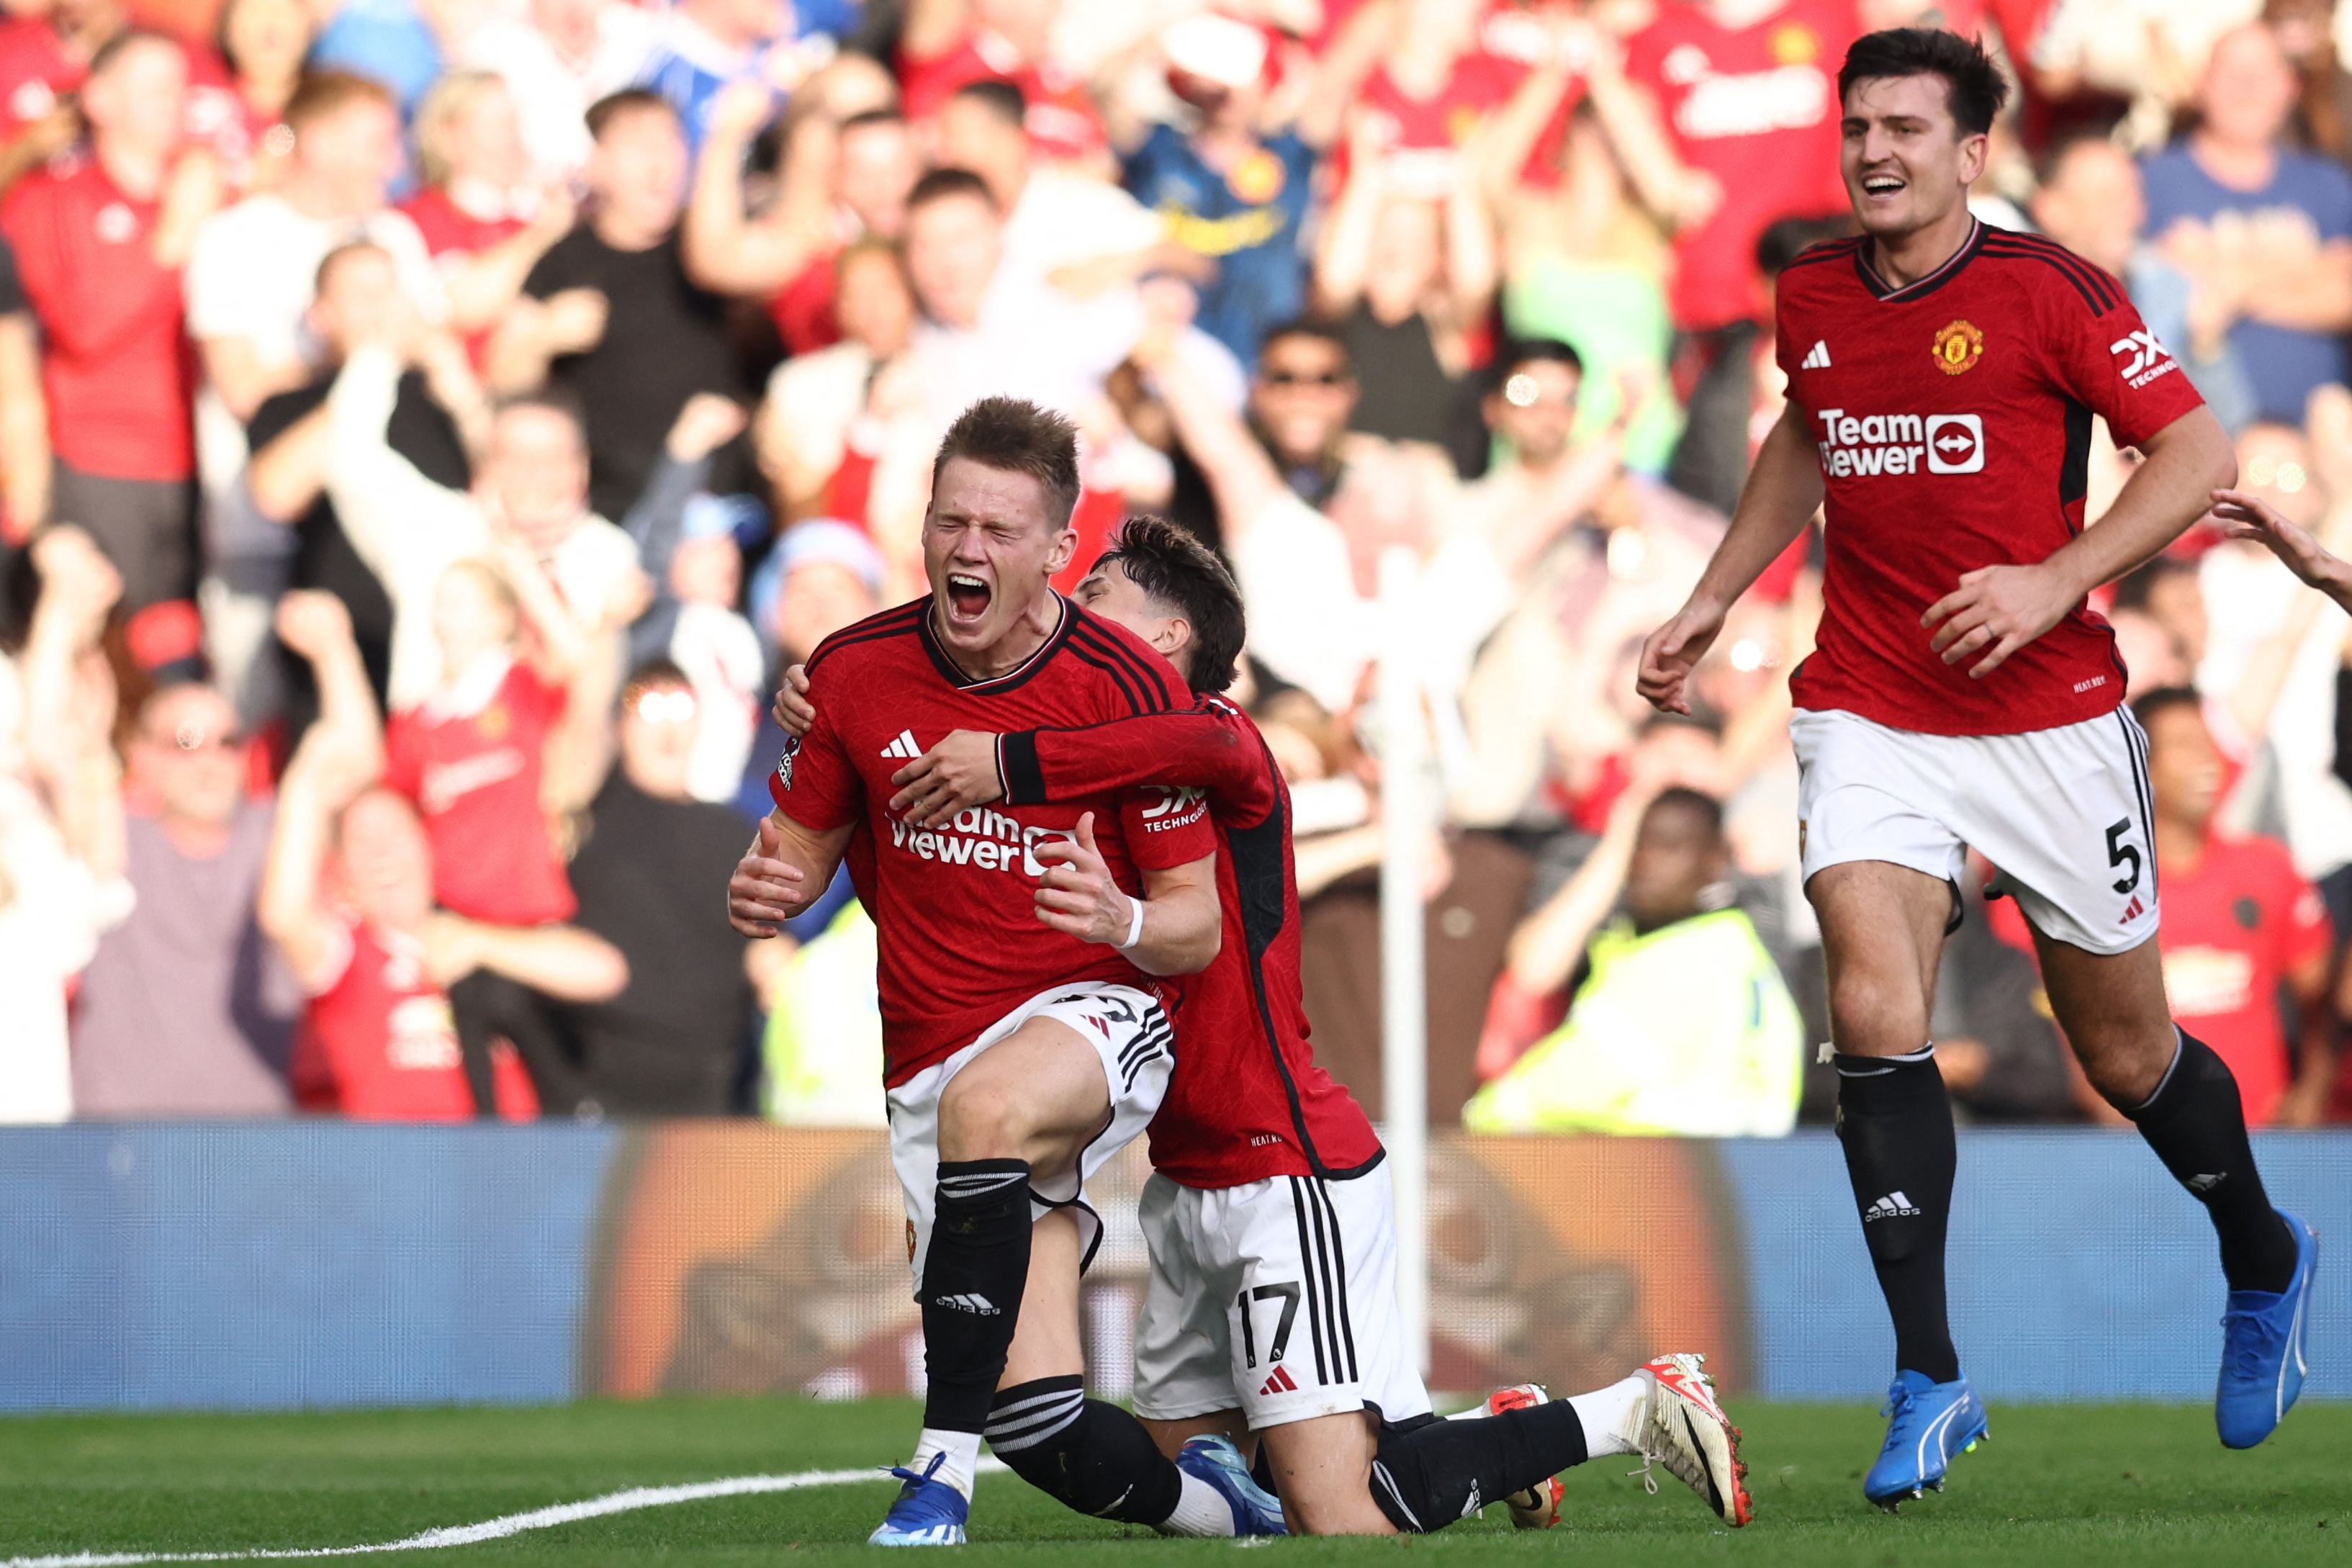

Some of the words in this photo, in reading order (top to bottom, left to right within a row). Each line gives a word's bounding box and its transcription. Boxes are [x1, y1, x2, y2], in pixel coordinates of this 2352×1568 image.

[1818, 408, 1923, 446] Team
[1144, 801, 1207, 833] TECHNOLOGY
[884, 811, 1020, 872] Viewer
[2104, 816, 2141, 895] 5
[1865, 1207, 1921, 1222] adidas
[936, 1297, 1001, 1316] adidas
[1238, 1280, 1302, 1370] 17
